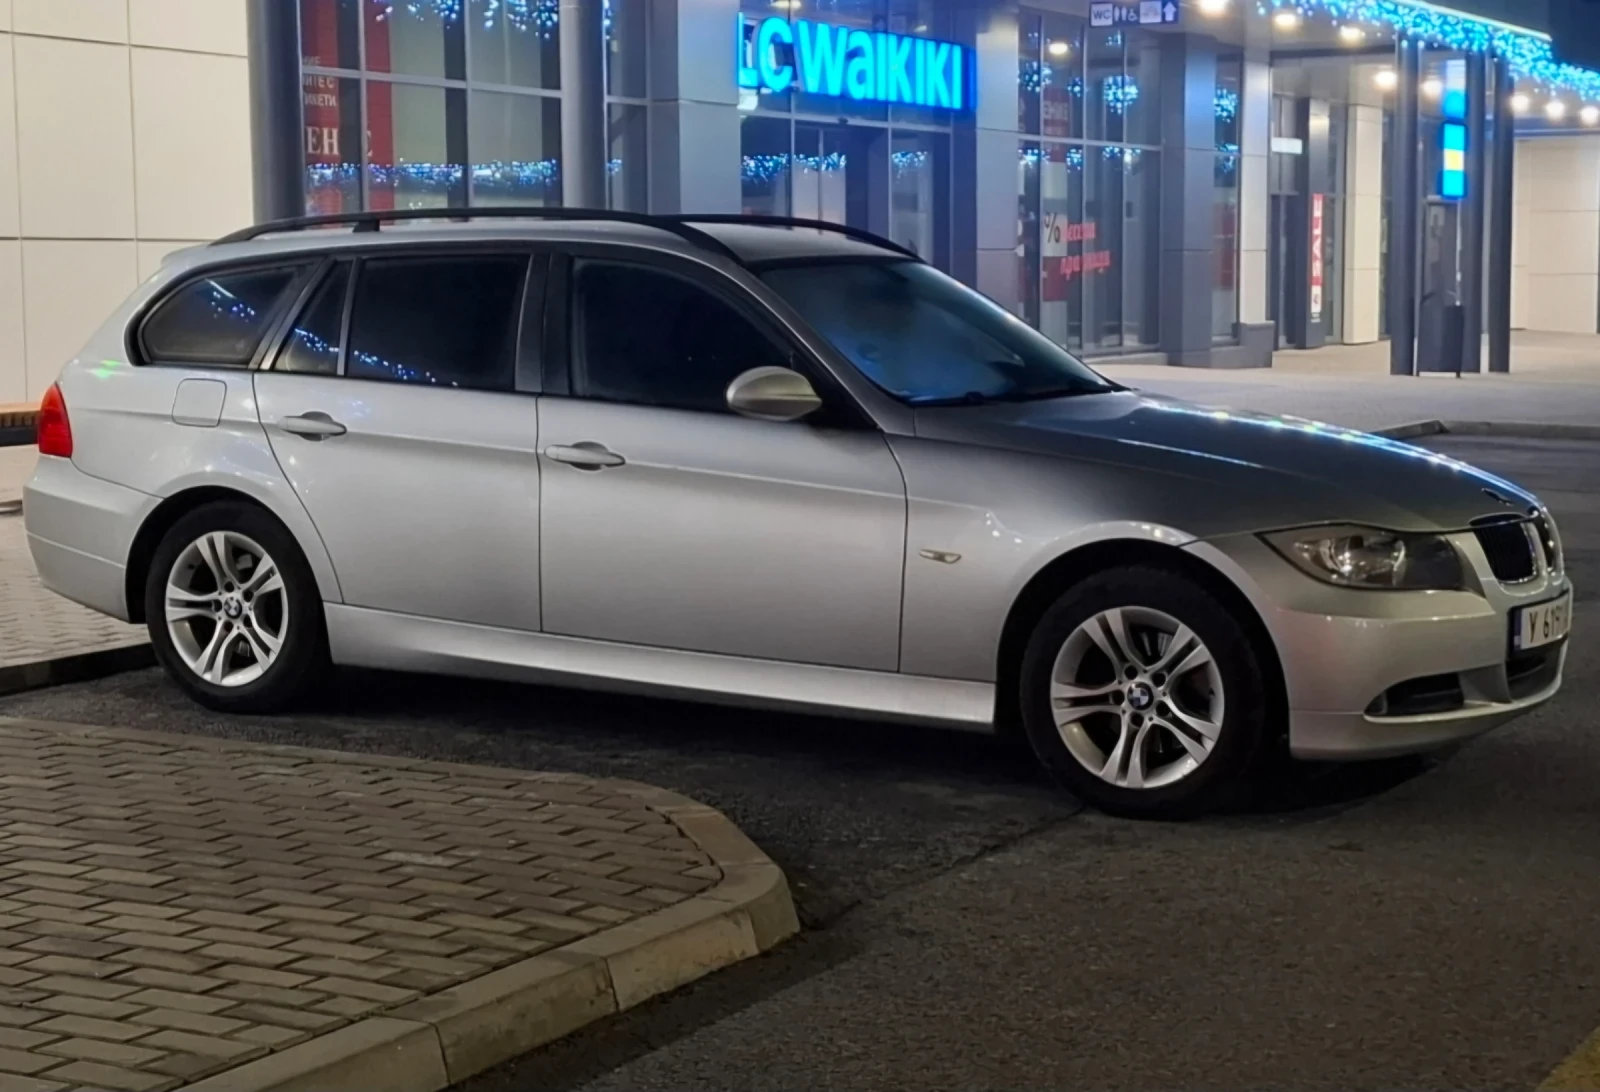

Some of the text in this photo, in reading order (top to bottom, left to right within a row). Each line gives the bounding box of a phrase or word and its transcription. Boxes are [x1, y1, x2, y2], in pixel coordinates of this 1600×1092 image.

[737, 11, 794, 92] LC
[1093, 9, 1111, 20] WC
[1312, 198, 1323, 278] SALE
